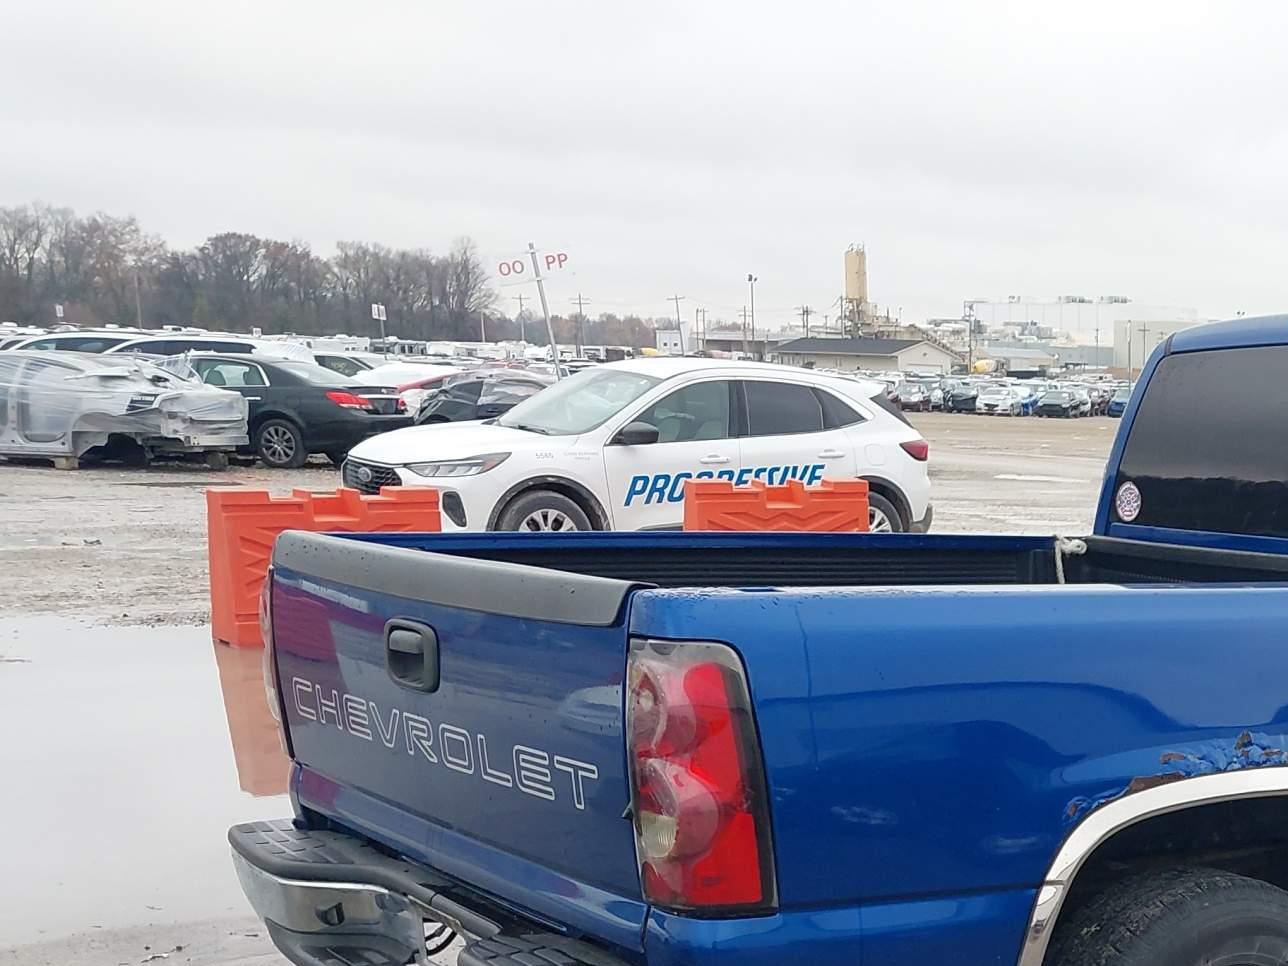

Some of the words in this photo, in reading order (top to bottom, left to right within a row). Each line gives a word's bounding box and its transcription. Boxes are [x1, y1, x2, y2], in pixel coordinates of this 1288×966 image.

[499, 260, 524, 276] OO
[545, 253, 568, 270] PP
[292, 677, 598, 810] CHEVROLET
